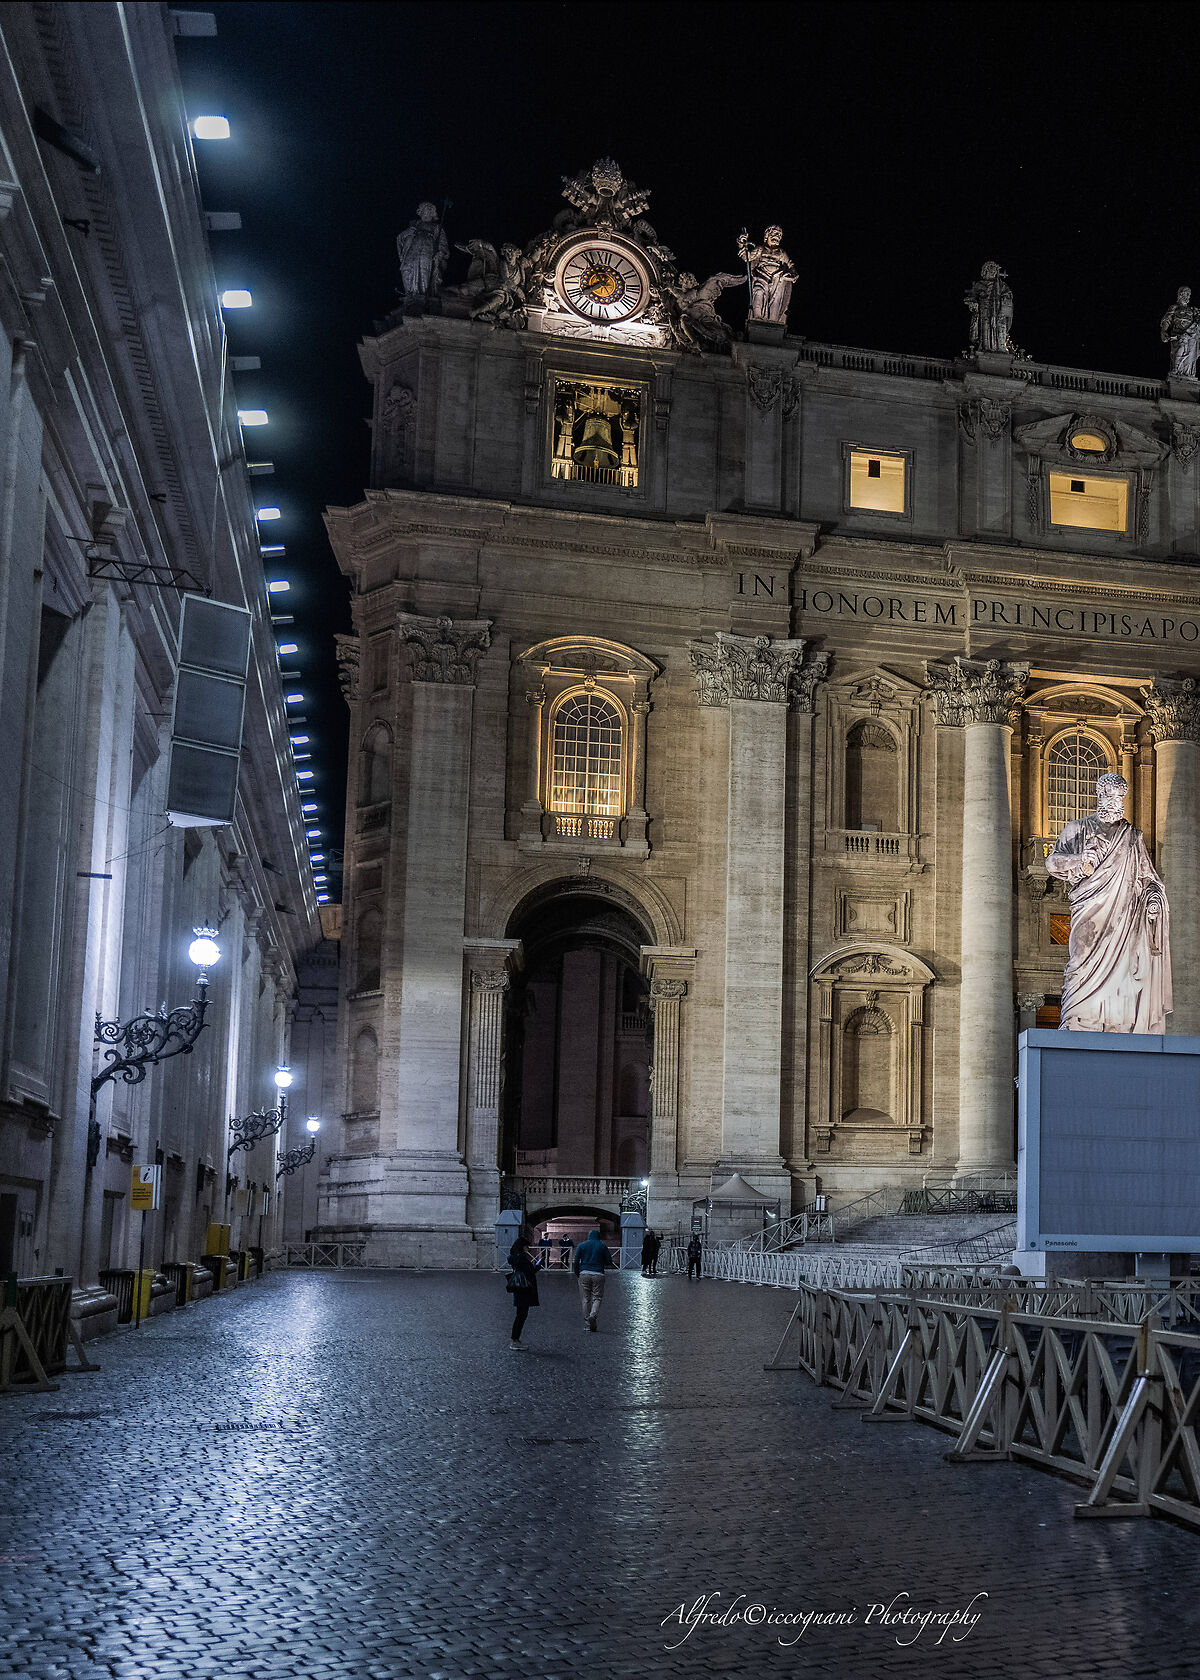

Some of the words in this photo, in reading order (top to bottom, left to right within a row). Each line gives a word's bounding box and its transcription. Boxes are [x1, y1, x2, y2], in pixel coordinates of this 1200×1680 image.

[736, 572, 776, 598] IN
[792, 589, 958, 626] HONOREM
[972, 599, 1133, 636] PRINCIPIS
[1044, 1240, 1078, 1248] Panasonic
